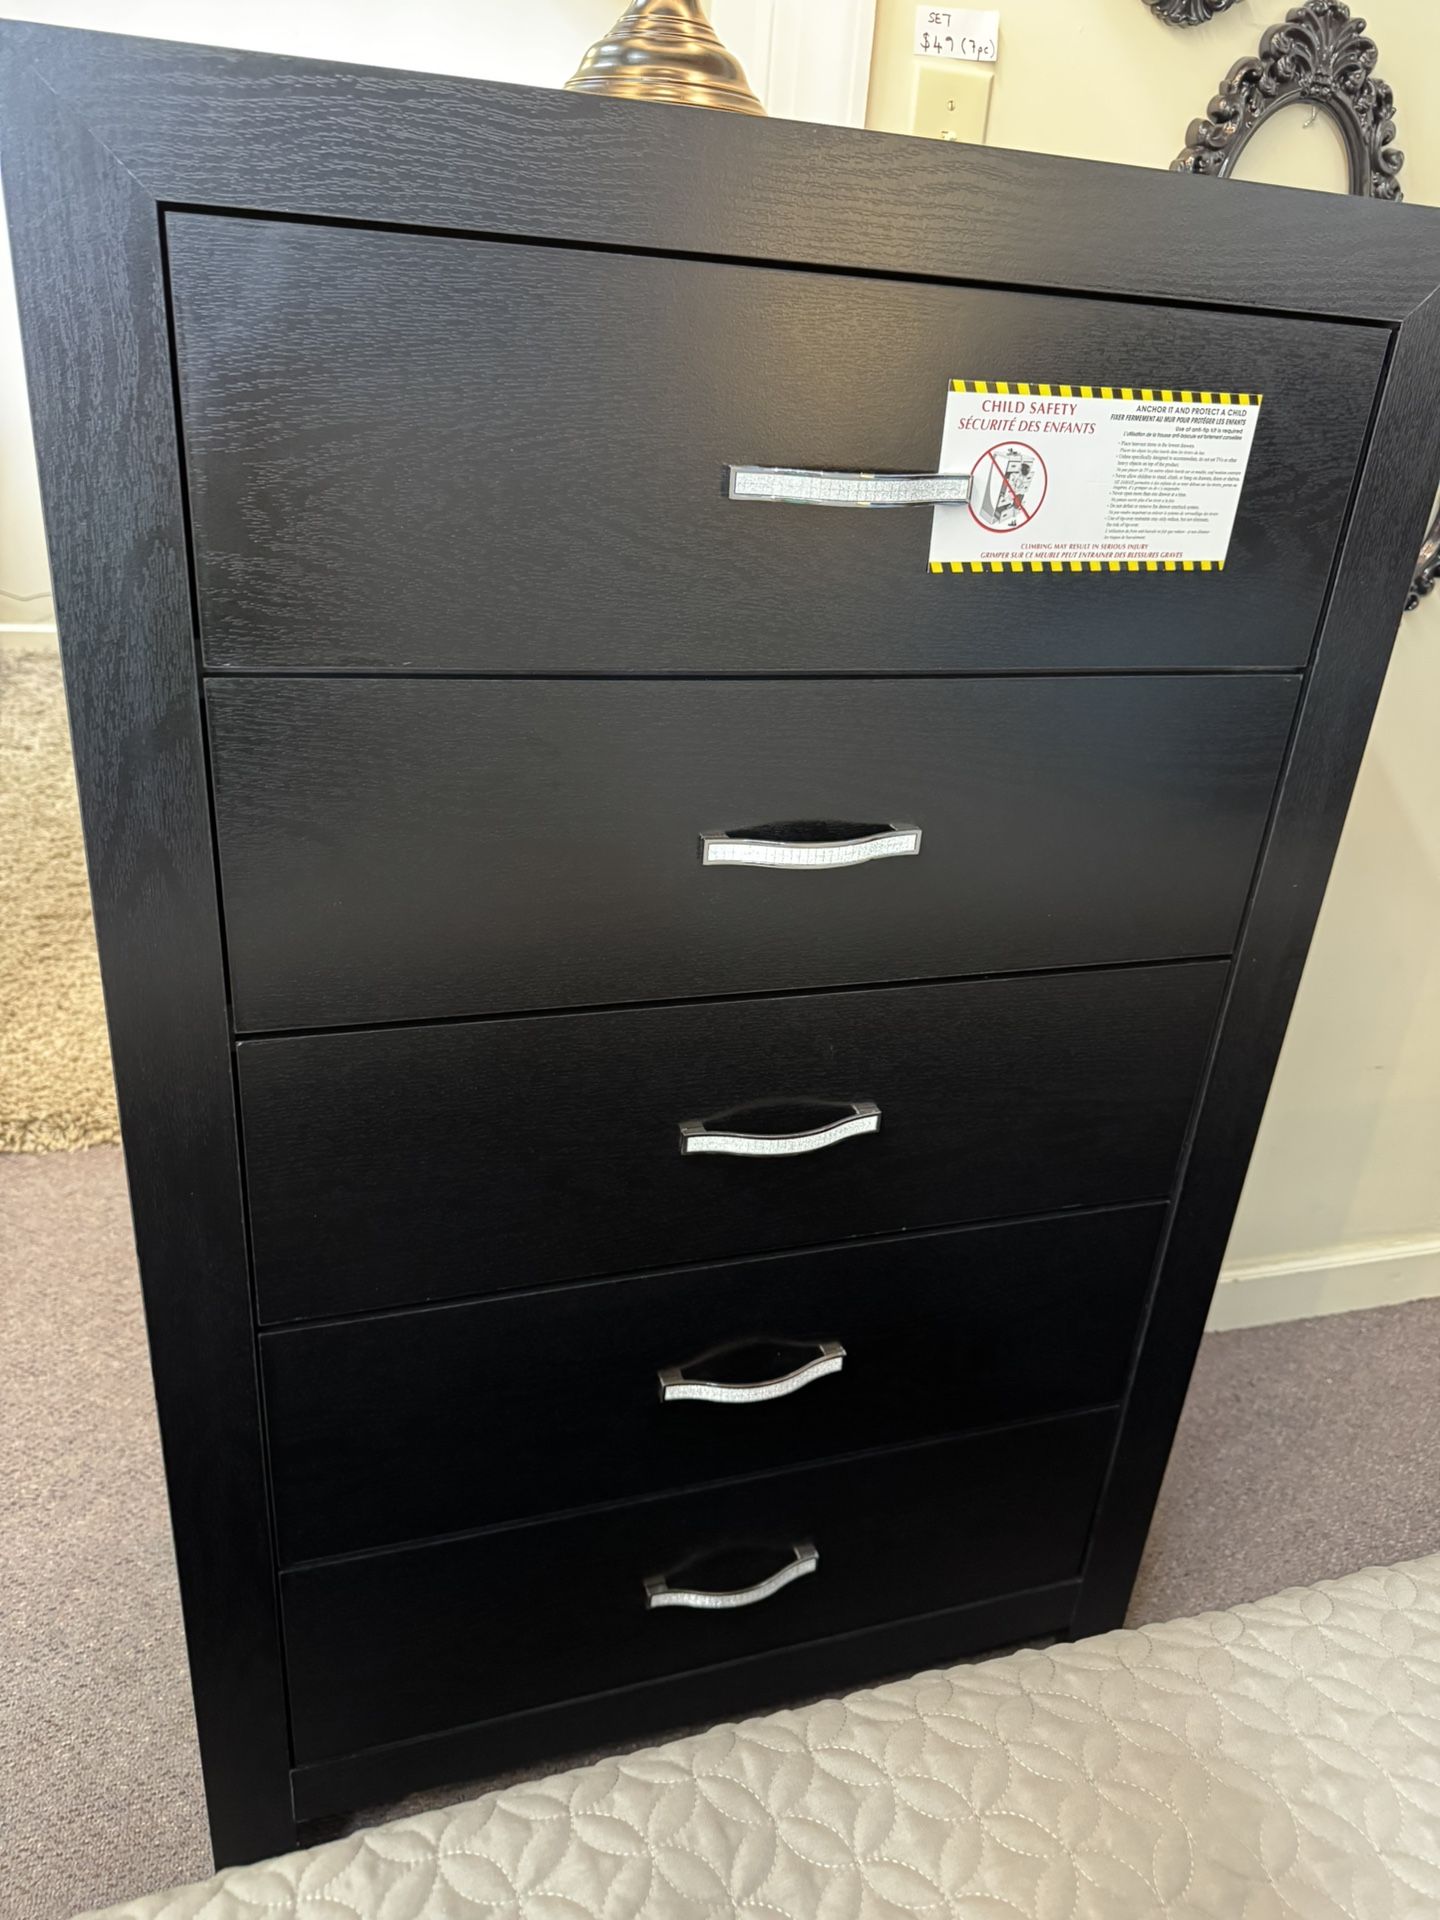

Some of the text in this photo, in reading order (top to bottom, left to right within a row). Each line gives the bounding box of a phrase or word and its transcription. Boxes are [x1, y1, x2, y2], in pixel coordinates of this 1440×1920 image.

[920, 32, 995, 61] $49 (7pc)
[982, 400, 1077, 415] CHILD SAFETY
[1136, 405, 1166, 413] ANCHOR
[1175, 406, 1190, 414] AND
[1191, 407, 1220, 416] PROTECT
[1227, 409, 1247, 417] CHILD
[958, 415, 1096, 434] SÉCURITÉ DES ENFANTS
[1125, 414, 1155, 422] FERMEMENT
[1176, 416, 1190, 424] POUR
[1191, 416, 1215, 425] PROTÉGER
[1225, 418, 1246, 426] ENFANTS
